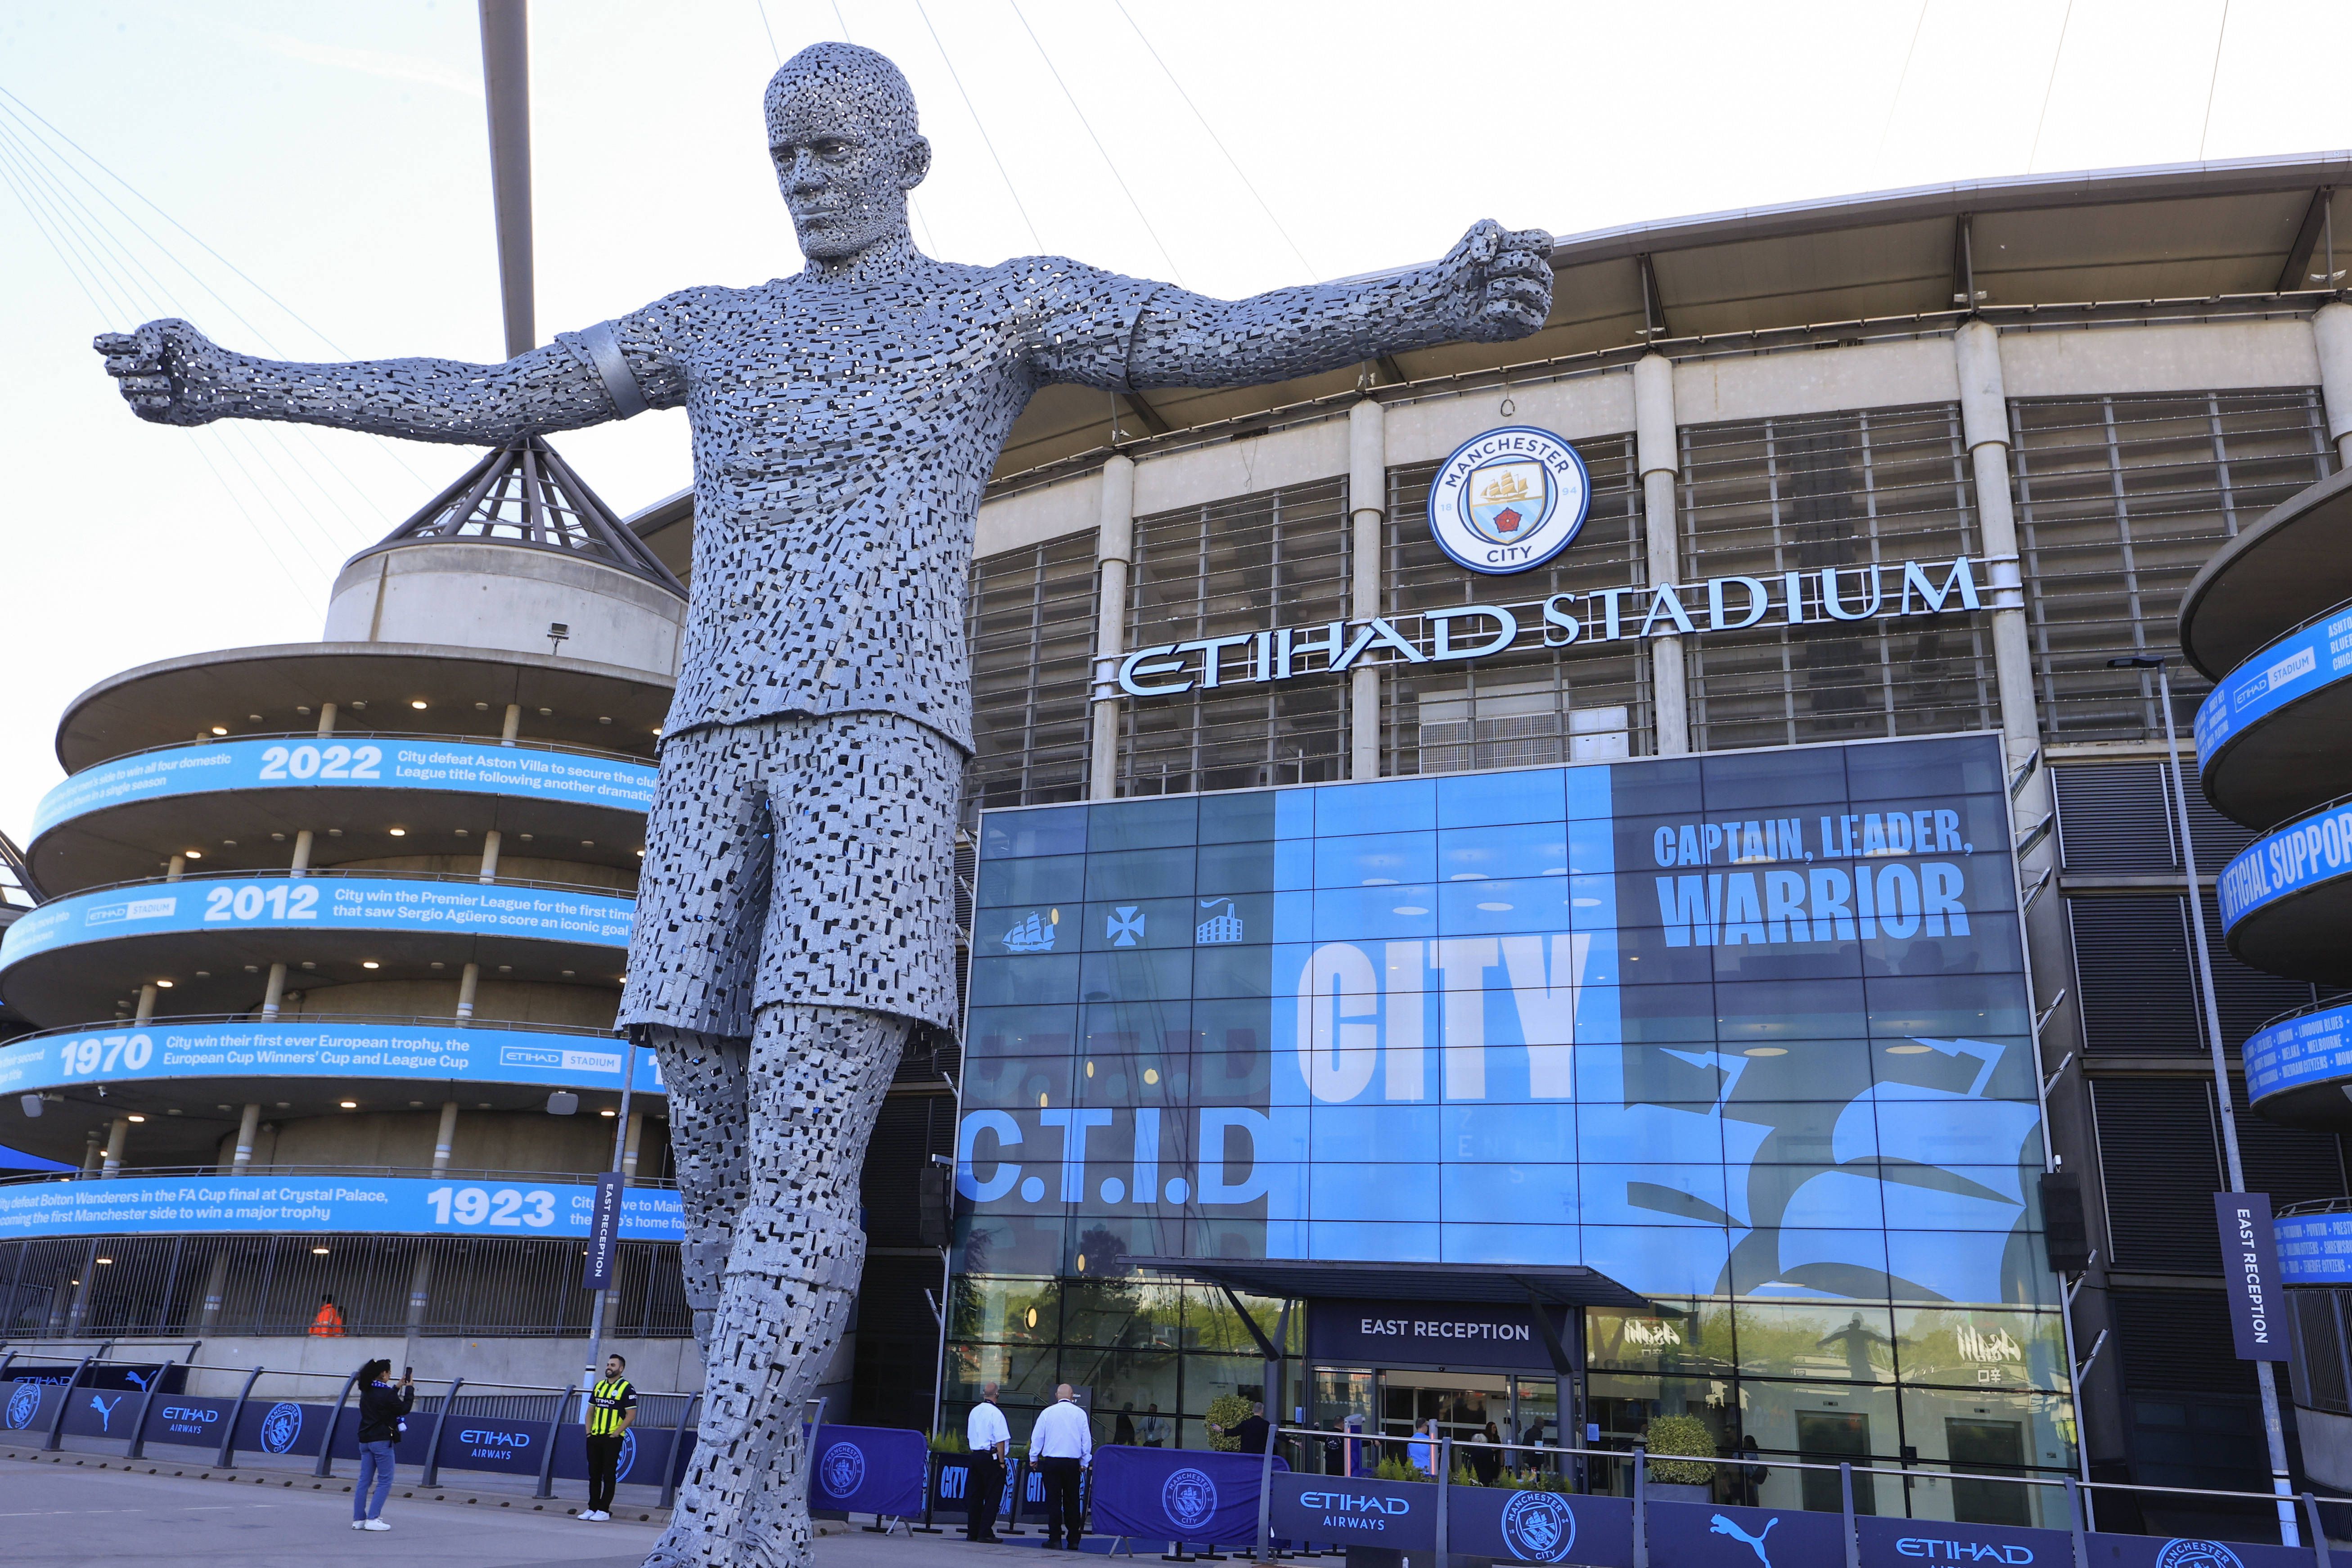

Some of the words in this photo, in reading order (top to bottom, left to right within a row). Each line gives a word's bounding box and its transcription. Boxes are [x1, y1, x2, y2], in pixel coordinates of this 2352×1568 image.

[1445, 437, 1569, 488] MANCHESTER
[1562, 487, 1577, 496] 94
[1440, 503, 1452, 511] 18
[1487, 545, 1532, 563] CITY
[1117, 604, 1517, 698] ETIHAD
[1543, 556, 1983, 649] STADIUM
[2237, 680, 2266, 704] ETIHAD
[2273, 656, 2309, 681] STADIUM
[117, 770, 126, 780] to
[127, 766, 143, 778] win
[144, 761, 157, 773] all
[158, 760, 178, 771] four
[179, 753, 231, 768] domestic
[259, 745, 382, 779] 2022
[398, 751, 426, 764] City
[429, 752, 474, 765] defeat
[475, 755, 516, 770] Aston
[519, 759, 549, 773] Villa
[551, 762, 565, 774] to
[567, 766, 611, 780] secure
[613, 771, 634, 784] the
[106, 784, 130, 796] single
[131, 777, 167, 790] season
[396, 766, 446, 780] League
[449, 769, 476, 781] title
[479, 771, 541, 789] following
[544, 779, 595, 793] another
[597, 782, 653, 802] dramatic
[1654, 818, 1813, 867] CAPTAIN,
[1820, 809, 1974, 858] LEADER,
[2222, 850, 2271, 920] OFFICIAL
[90, 909, 126, 920] ETIHAD
[133, 904, 170, 915] STADIUM
[204, 885, 319, 921] 2012
[335, 888, 363, 903] City
[367, 890, 392, 902] win
[395, 891, 418, 902] the
[421, 892, 478, 906] Premier
[480, 895, 530, 911] League
[533, 899, 553, 912] for
[555, 902, 577, 915] the
[579, 904, 606, 918] first
[1655, 862, 1971, 948] WARRIOR
[333, 905, 362, 917] that
[365, 908, 395, 918] saw
[397, 906, 443, 921] Sergio
[445, 909, 496, 924] Agüero
[500, 914, 538, 927] score
[541, 918, 558, 928] an
[560, 918, 599, 933] iconic
[601, 924, 629, 937] goal
[1297, 933, 1591, 1103] CITY
[2324, 1015, 2343, 1032] BLUES
[166, 1036, 192, 1050] City
[194, 1035, 217, 1047] win
[220, 1034, 252, 1047] their
[253, 1034, 282, 1047] first
[284, 1037, 317, 1047] ever
[319, 1034, 388, 1051] European
[391, 1038, 443, 1053] trophy,
[446, 1039, 470, 1052] the
[2307, 1034, 2343, 1054] MELBOURNE
[60, 1034, 153, 1076] 1970
[163, 1051, 224, 1066] European
[226, 1051, 255, 1066] Cup
[257, 1051, 318, 1063] Winners'
[321, 1051, 350, 1067] Cup
[352, 1053, 381, 1065] and
[383, 1053, 437, 1068] League
[439, 1054, 469, 1070] Cup
[506, 1052, 559, 1063] ETIHAD
[570, 1056, 615, 1068] STADIUM
[2303, 1056, 2328, 1072] CITYZENS
[10, 1196, 40, 1209] defeat
[41, 1194, 74, 1207] Bolton
[76, 1191, 139, 1205] Wanderers
[141, 1190, 153, 1202] in
[154, 1190, 176, 1201] the
[178, 1188, 197, 1201] FA
[198, 1189, 226, 1203] Cup
[229, 1188, 260, 1201] final
[261, 1189, 276, 1201] at
[279, 1188, 333, 1203] Crystal
[335, 1189, 388, 1204] Palace,
[427, 1187, 555, 1227] 1923
[571, 1196, 595, 1211] City
[639, 1200, 651, 1211] to
[603, 1184, 613, 1212] EAST
[32, 1211, 49, 1223] the
[50, 1210, 72, 1223] first
[74, 1208, 147, 1221] Manchester
[149, 1207, 177, 1219] side
[179, 1208, 194, 1219] to
[196, 1206, 221, 1218] win
[225, 1209, 233, 1218] a
[236, 1206, 278, 1221] major
[281, 1206, 331, 1221] trophy
[570, 1212, 592, 1226] the
[635, 1216, 669, 1228] home
[2237, 1208, 2255, 1248] EAST
[595, 1214, 609, 1277] RECEPTION
[2322, 1259, 2345, 1272] CITYZENS
[2243, 1253, 2268, 1343] RECEPTION
[1361, 1319, 1408, 1335] EAST
[1415, 1320, 1529, 1341] RECEPTION
[162, 1407, 218, 1423] ETIHAD
[267, 1403, 298, 1425] MANCHESTER
[170, 1424, 203, 1435] AIRWAYS
[460, 1430, 530, 1447] ETIHAD
[274, 1444, 286, 1453] CITY
[471, 1448, 512, 1460] AIRWAYS
[825, 1446, 861, 1465] MANCHESTER
[941, 1465, 969, 1499] CITY
[1169, 1473, 1212, 1493] MANCHESTER
[1300, 1491, 1410, 1515] ETIHAD
[1508, 1493, 1563, 1522] MANCHESTER
[1323, 1515, 1385, 1531] AIRWAYS
[1535, 1549, 1555, 1560] CITY
[1896, 1537, 2034, 1564] ETIHAD
[2164, 1542, 2230, 1568] MANCHESTER
